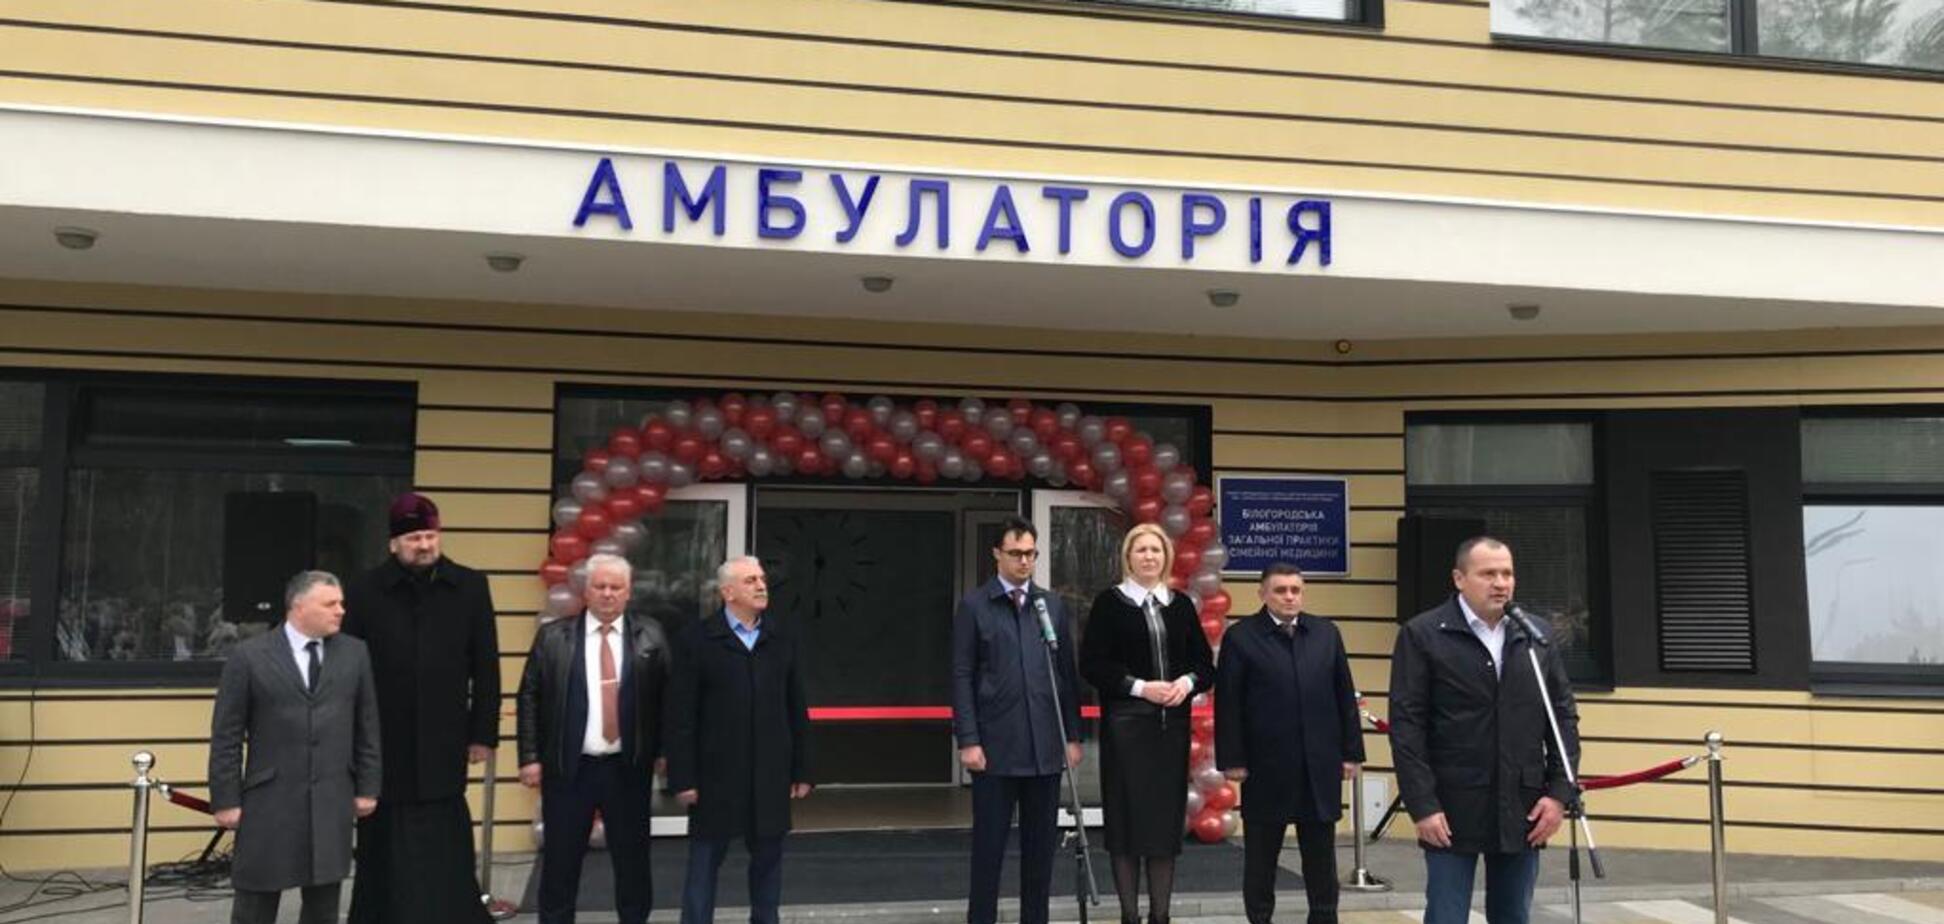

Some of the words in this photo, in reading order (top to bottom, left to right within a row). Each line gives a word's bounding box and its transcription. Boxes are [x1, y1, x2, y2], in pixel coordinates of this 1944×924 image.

[573, 157, 1334, 266] АМБУЛАТОРІЯ
[1241, 508, 1326, 520] БІЛОГОРОДСЬКА
[1248, 521, 1319, 533] АМБУЛАТОРІЯ
[1228, 534, 1284, 546] ЗАГАЛЬНОЇ
[1286, 535, 1340, 546] ПРАКТИКИ
[1229, 547, 1278, 558] СІМЕЙНОЇ
[1280, 547, 1339, 560] МЕДИЦИНИ
